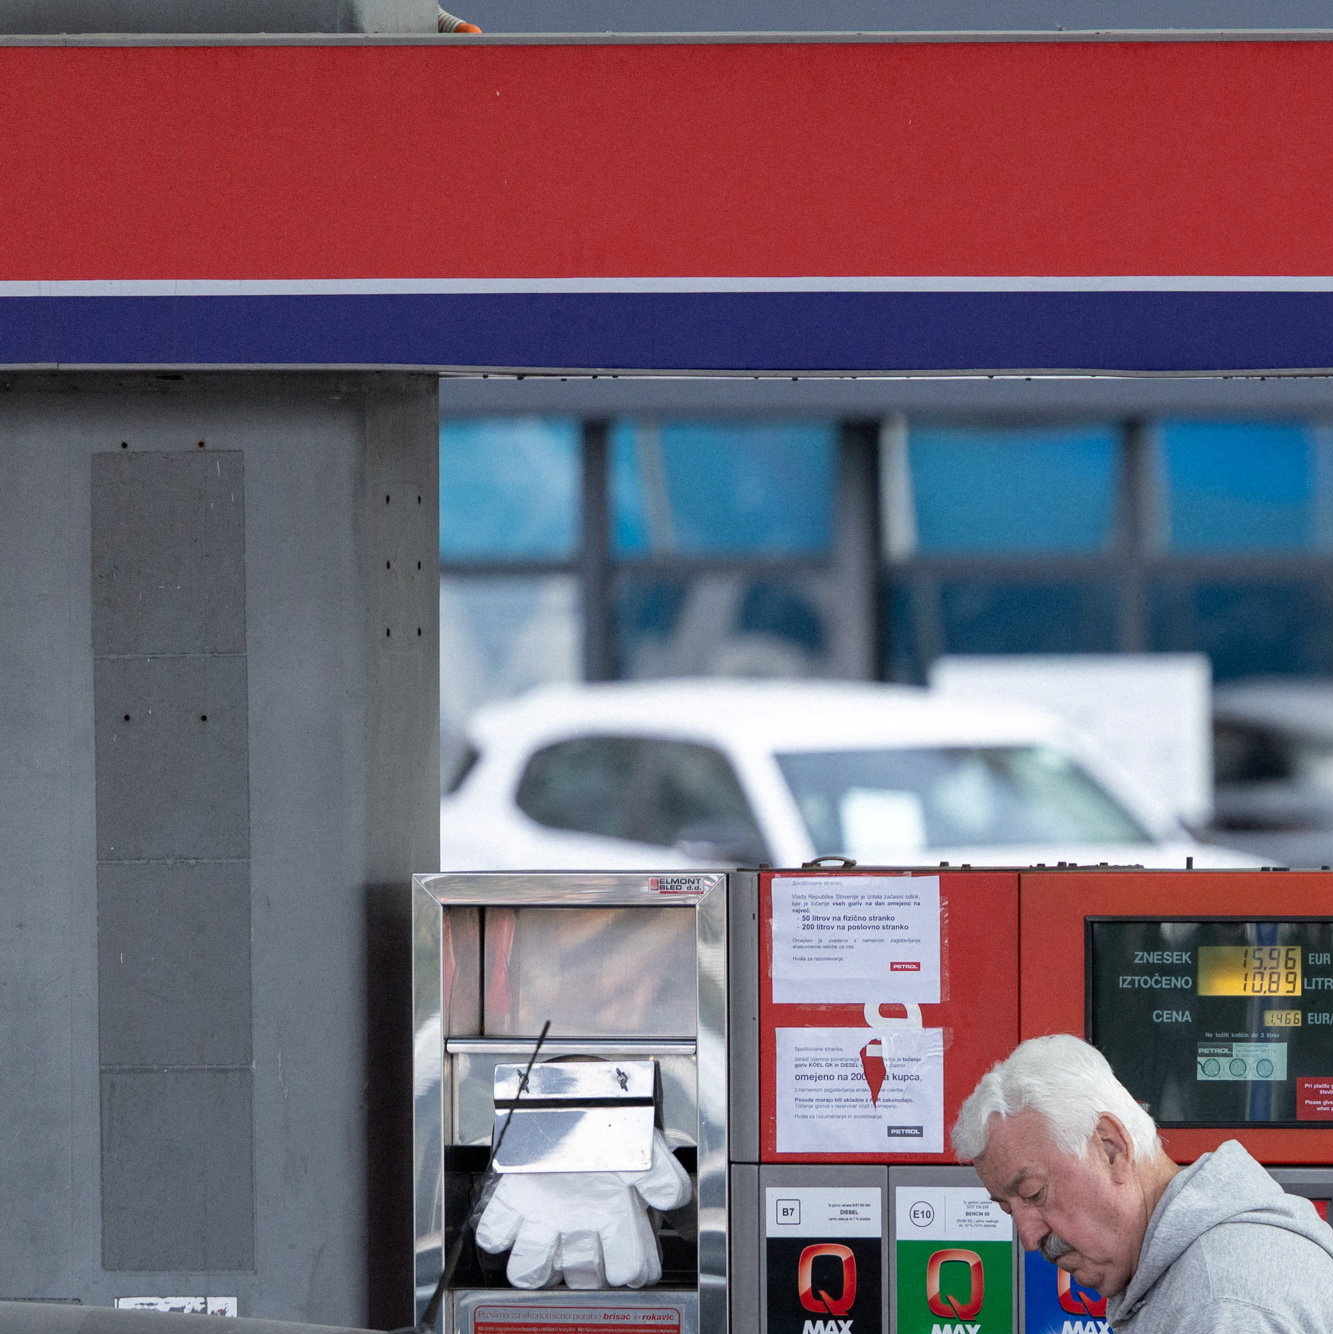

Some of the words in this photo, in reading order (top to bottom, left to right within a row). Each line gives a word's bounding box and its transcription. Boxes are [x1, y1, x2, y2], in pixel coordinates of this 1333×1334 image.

[848, 924, 880, 932] poslovno
[1134, 951, 1192, 965] ZNESEK
[1243, 948, 1297, 970] 15,96
[1308, 953, 1332, 965] EUR
[1119, 973, 1193, 989] IZTOČENO
[1243, 972, 1297, 994] 10,89
[1152, 1010, 1192, 1023] CENA
[1270, 1013, 1301, 1026] 1,466
[795, 1073, 834, 1082] omejeno
[892, 1073, 922, 1083] kupca,
[782, 1208, 795, 1217] B7
[913, 1210, 932, 1219] E10
[797, 1243, 857, 1316] Q
[926, 1248, 984, 1321] Q
[603, 1312, 631, 1321] brisač
[642, 1313, 674, 1321] rokavic
